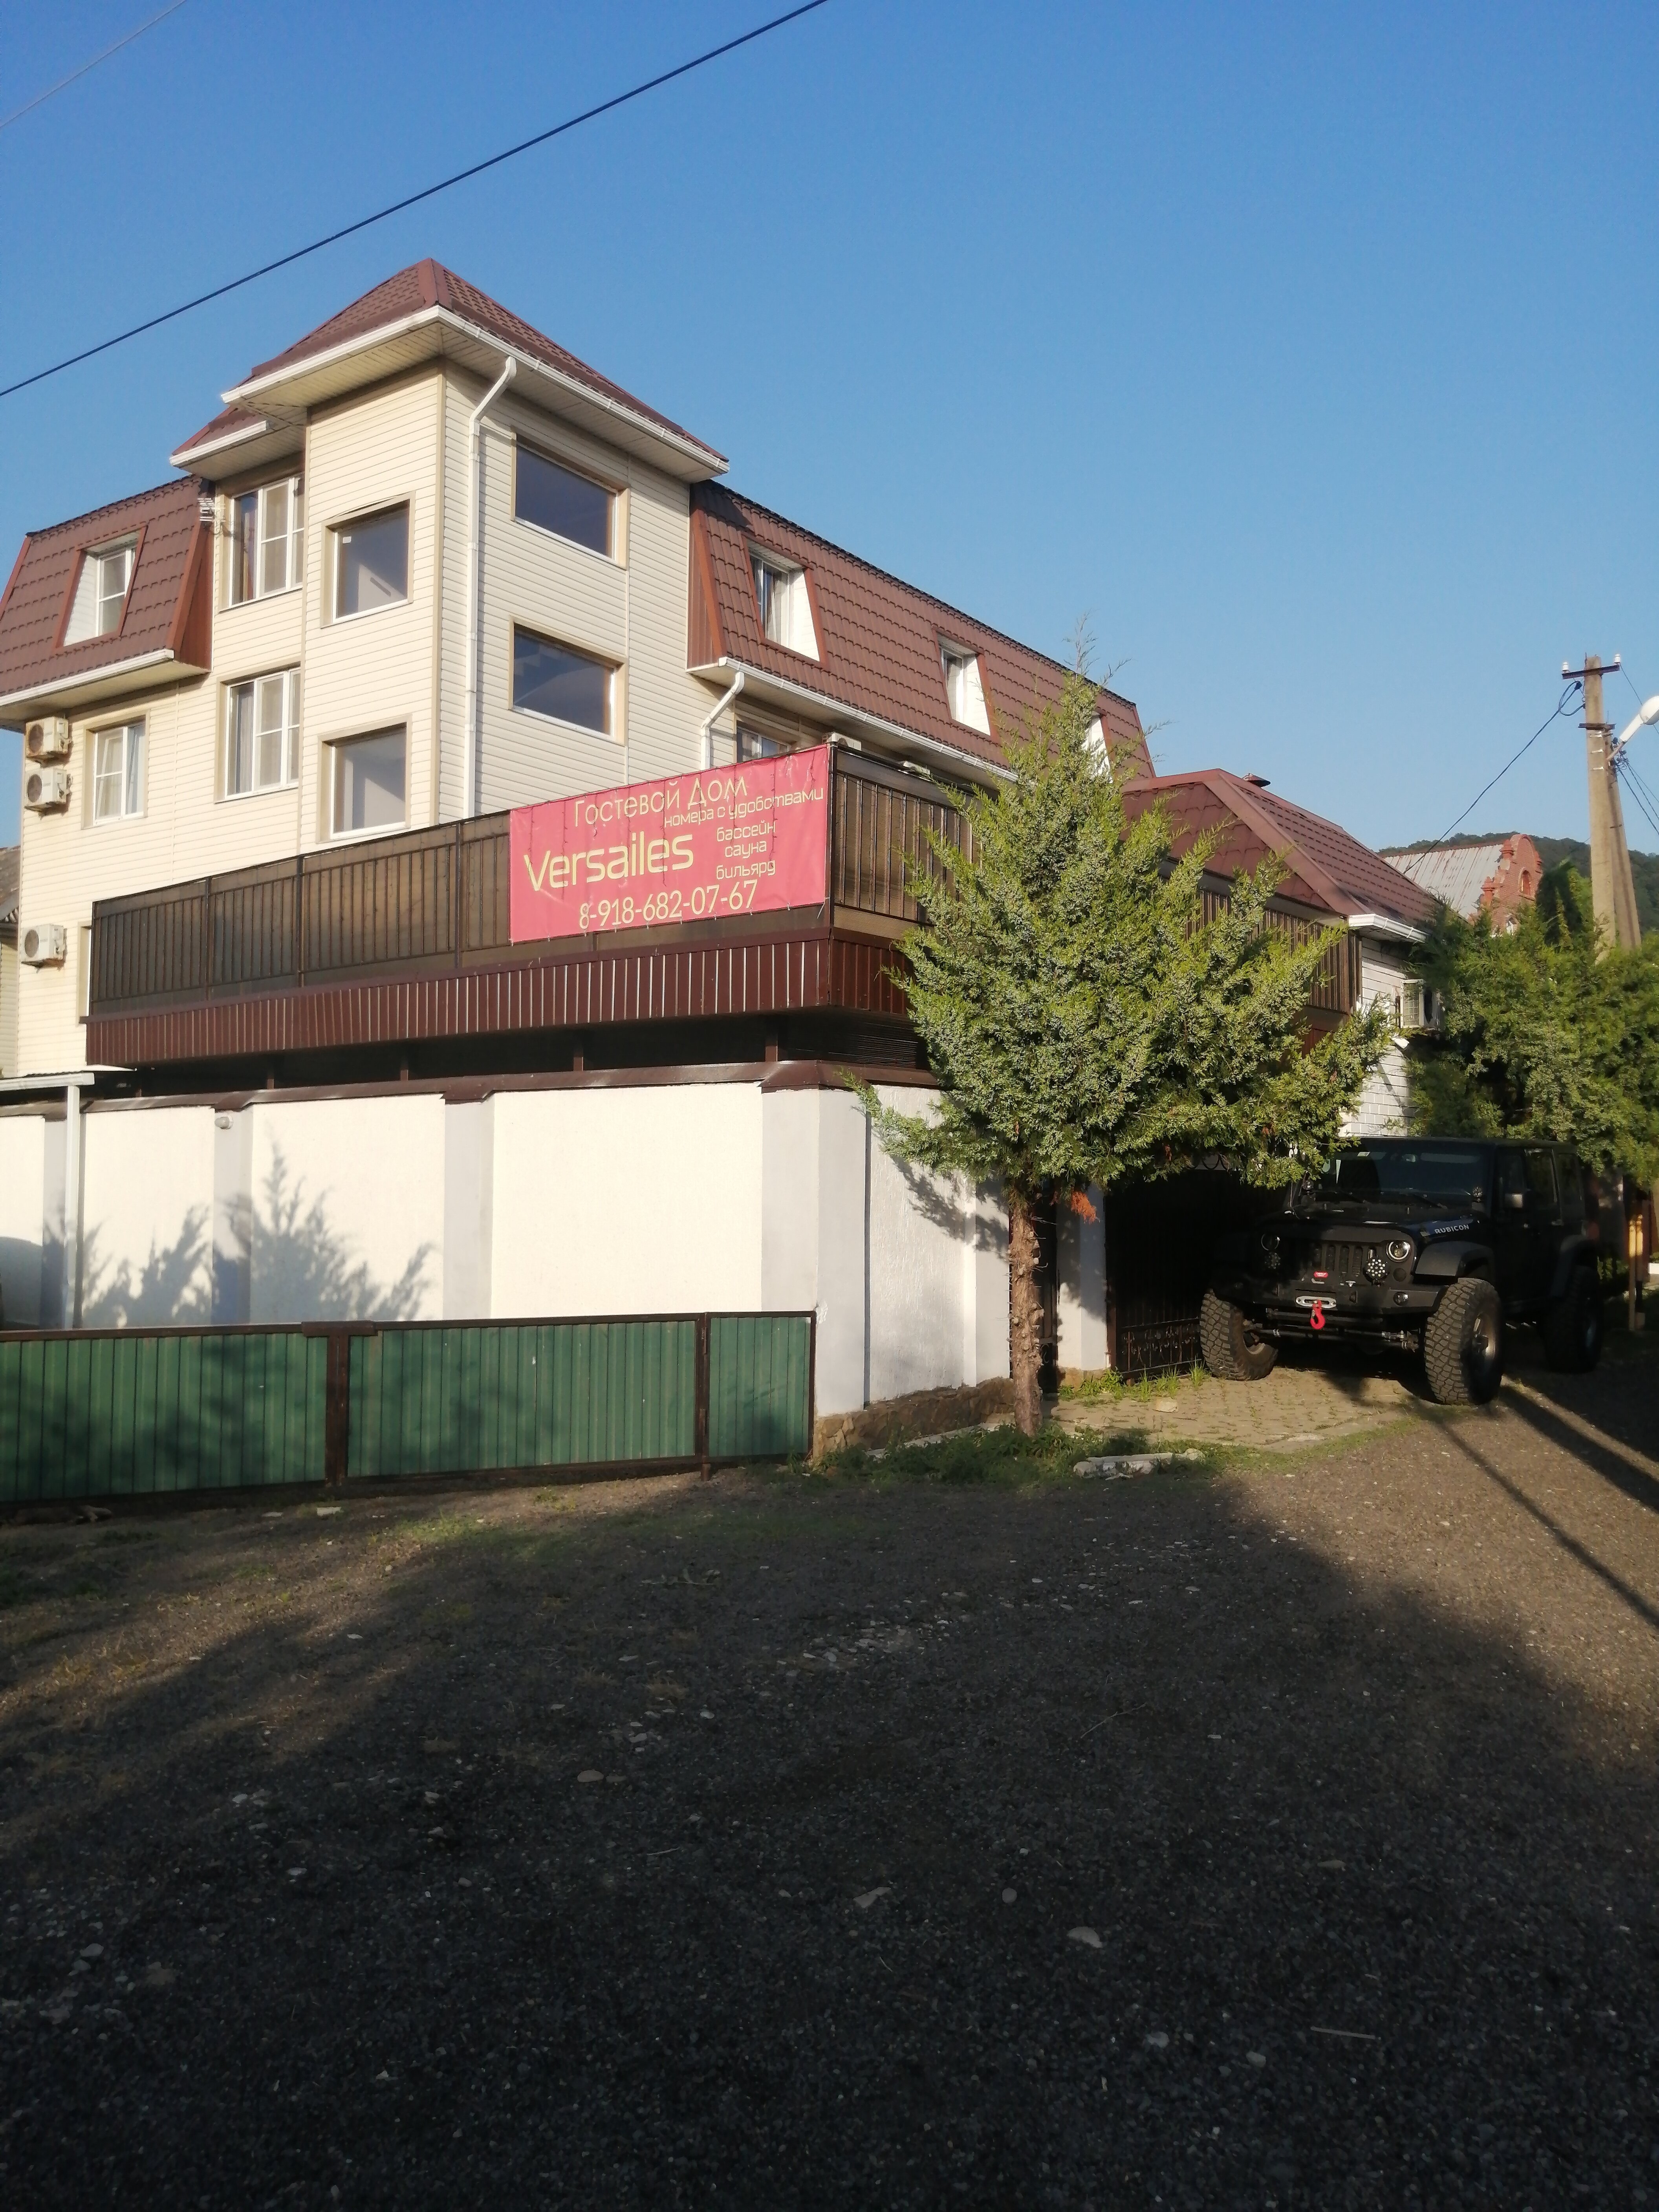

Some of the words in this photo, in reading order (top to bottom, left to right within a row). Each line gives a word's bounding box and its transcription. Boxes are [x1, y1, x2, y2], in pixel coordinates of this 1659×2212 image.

[575, 780, 680, 827] Гостевой
[665, 807, 714, 828] номера
[717, 806, 725, 818] с
[729, 787, 824, 820] удобствами
[716, 820, 776, 842] бассейн
[524, 831, 694, 891] Versailes
[725, 840, 767, 859] сауна
[716, 860, 776, 880] бильярд
[579, 879, 758, 930] 8-918-682-07-67
[1434, 1224, 1469, 1234] RUBICON
